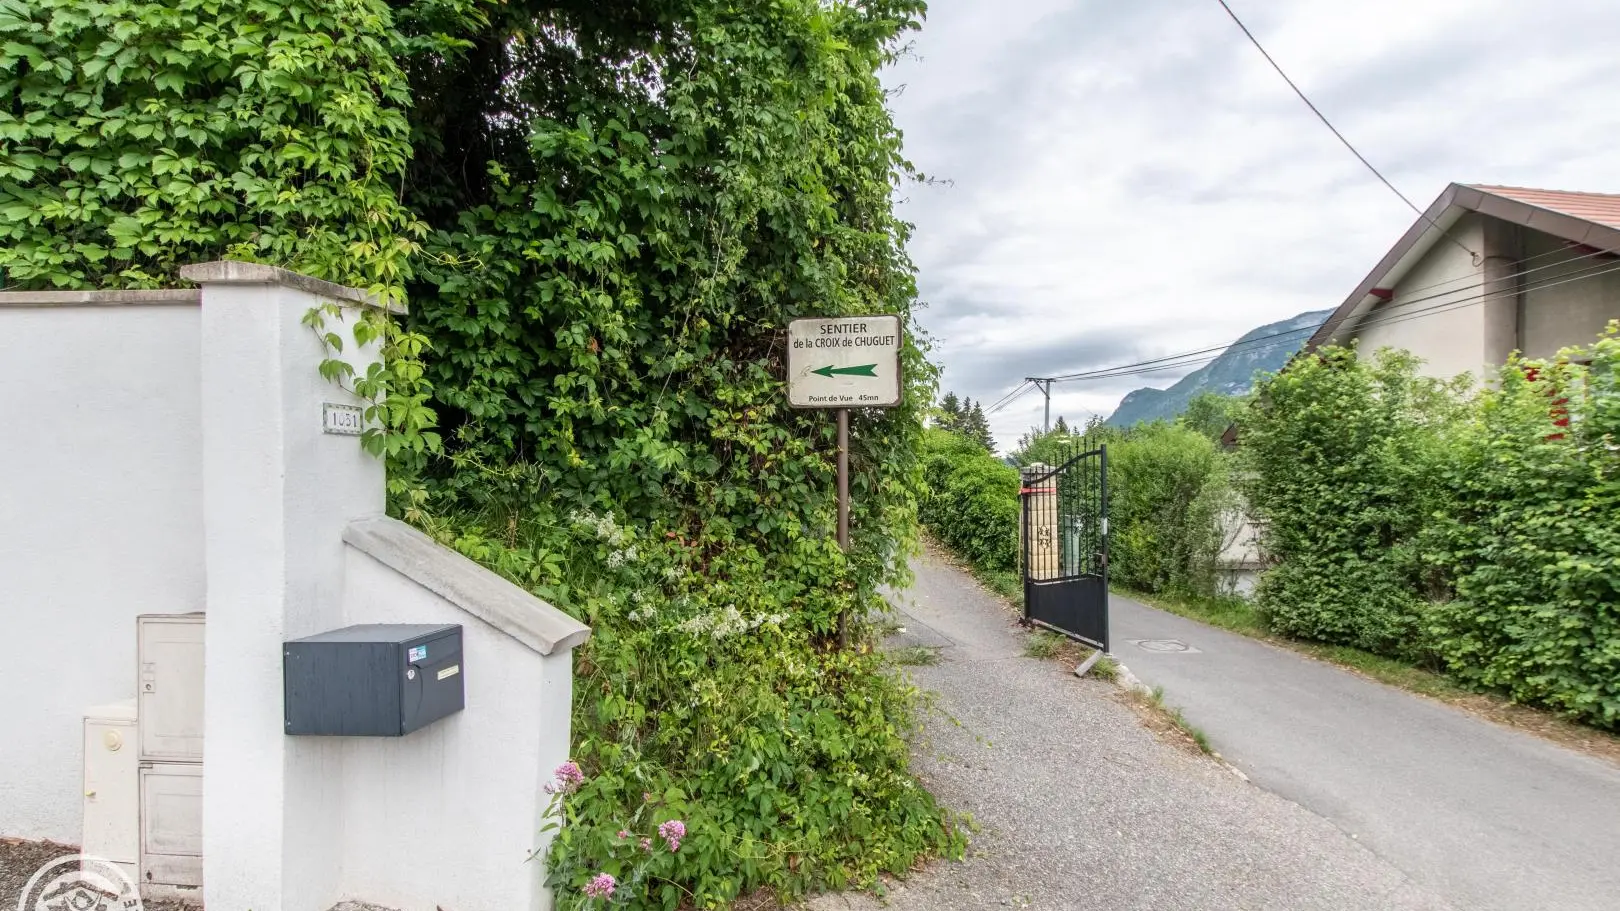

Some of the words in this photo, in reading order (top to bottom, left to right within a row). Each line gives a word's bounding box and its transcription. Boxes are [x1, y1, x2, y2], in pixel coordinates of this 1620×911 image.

[820, 323, 867, 334] SENTIER
[793, 338, 804, 349] de
[805, 338, 813, 348] la
[815, 337, 840, 348] CROIX
[842, 336, 853, 347] de
[854, 335, 895, 347] CHUGUET
[839, 394, 853, 402] Vue
